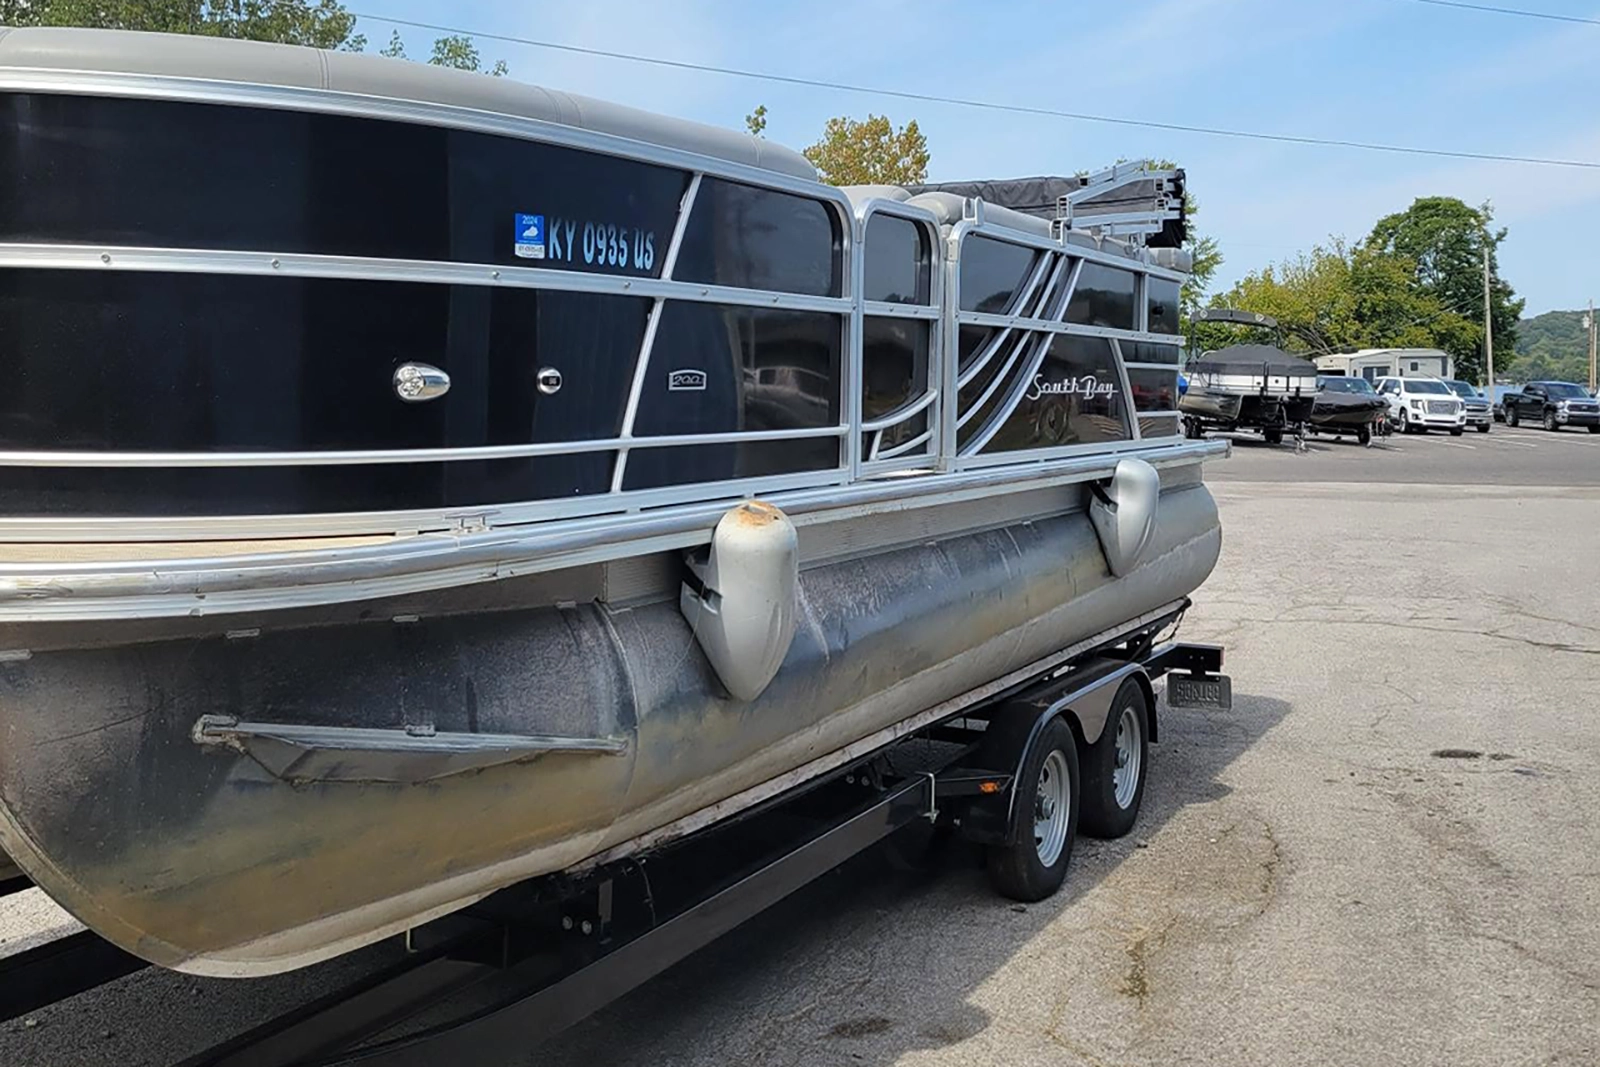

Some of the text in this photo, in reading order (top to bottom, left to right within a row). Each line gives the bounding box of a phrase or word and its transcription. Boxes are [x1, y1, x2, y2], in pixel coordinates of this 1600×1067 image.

[549, 217, 577, 261] KY
[583, 222, 628, 267] 0935
[1026, 374, 1119, 400] South Bay
